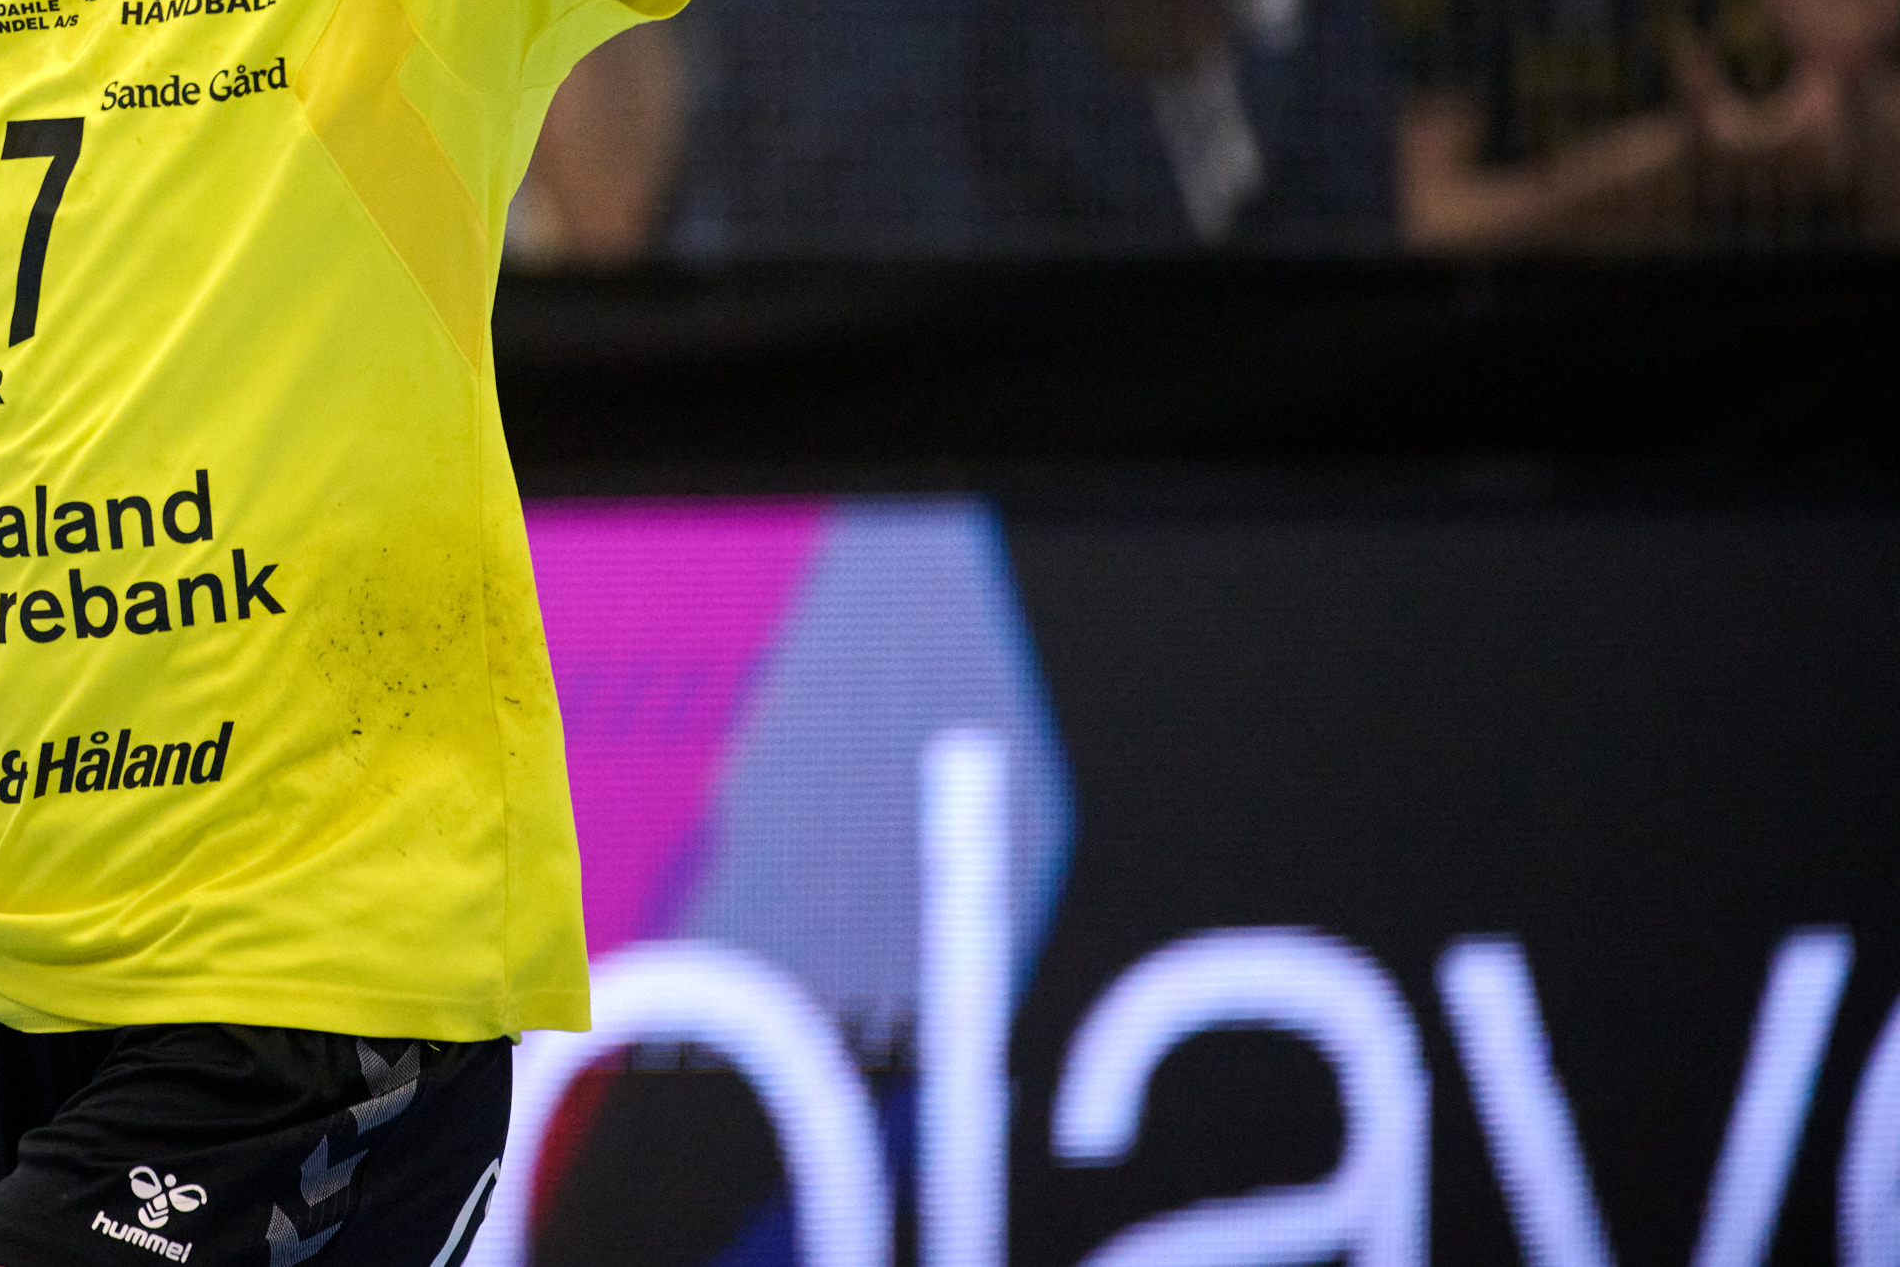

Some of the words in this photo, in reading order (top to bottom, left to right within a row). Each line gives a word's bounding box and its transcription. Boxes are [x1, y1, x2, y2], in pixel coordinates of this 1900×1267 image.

[54, 15, 79, 29] A/S
[101, 74, 200, 111] Sande
[209, 57, 289, 102] Gård
[33, 721, 234, 800] Håland
[91, 1211, 192, 1264] hummel
